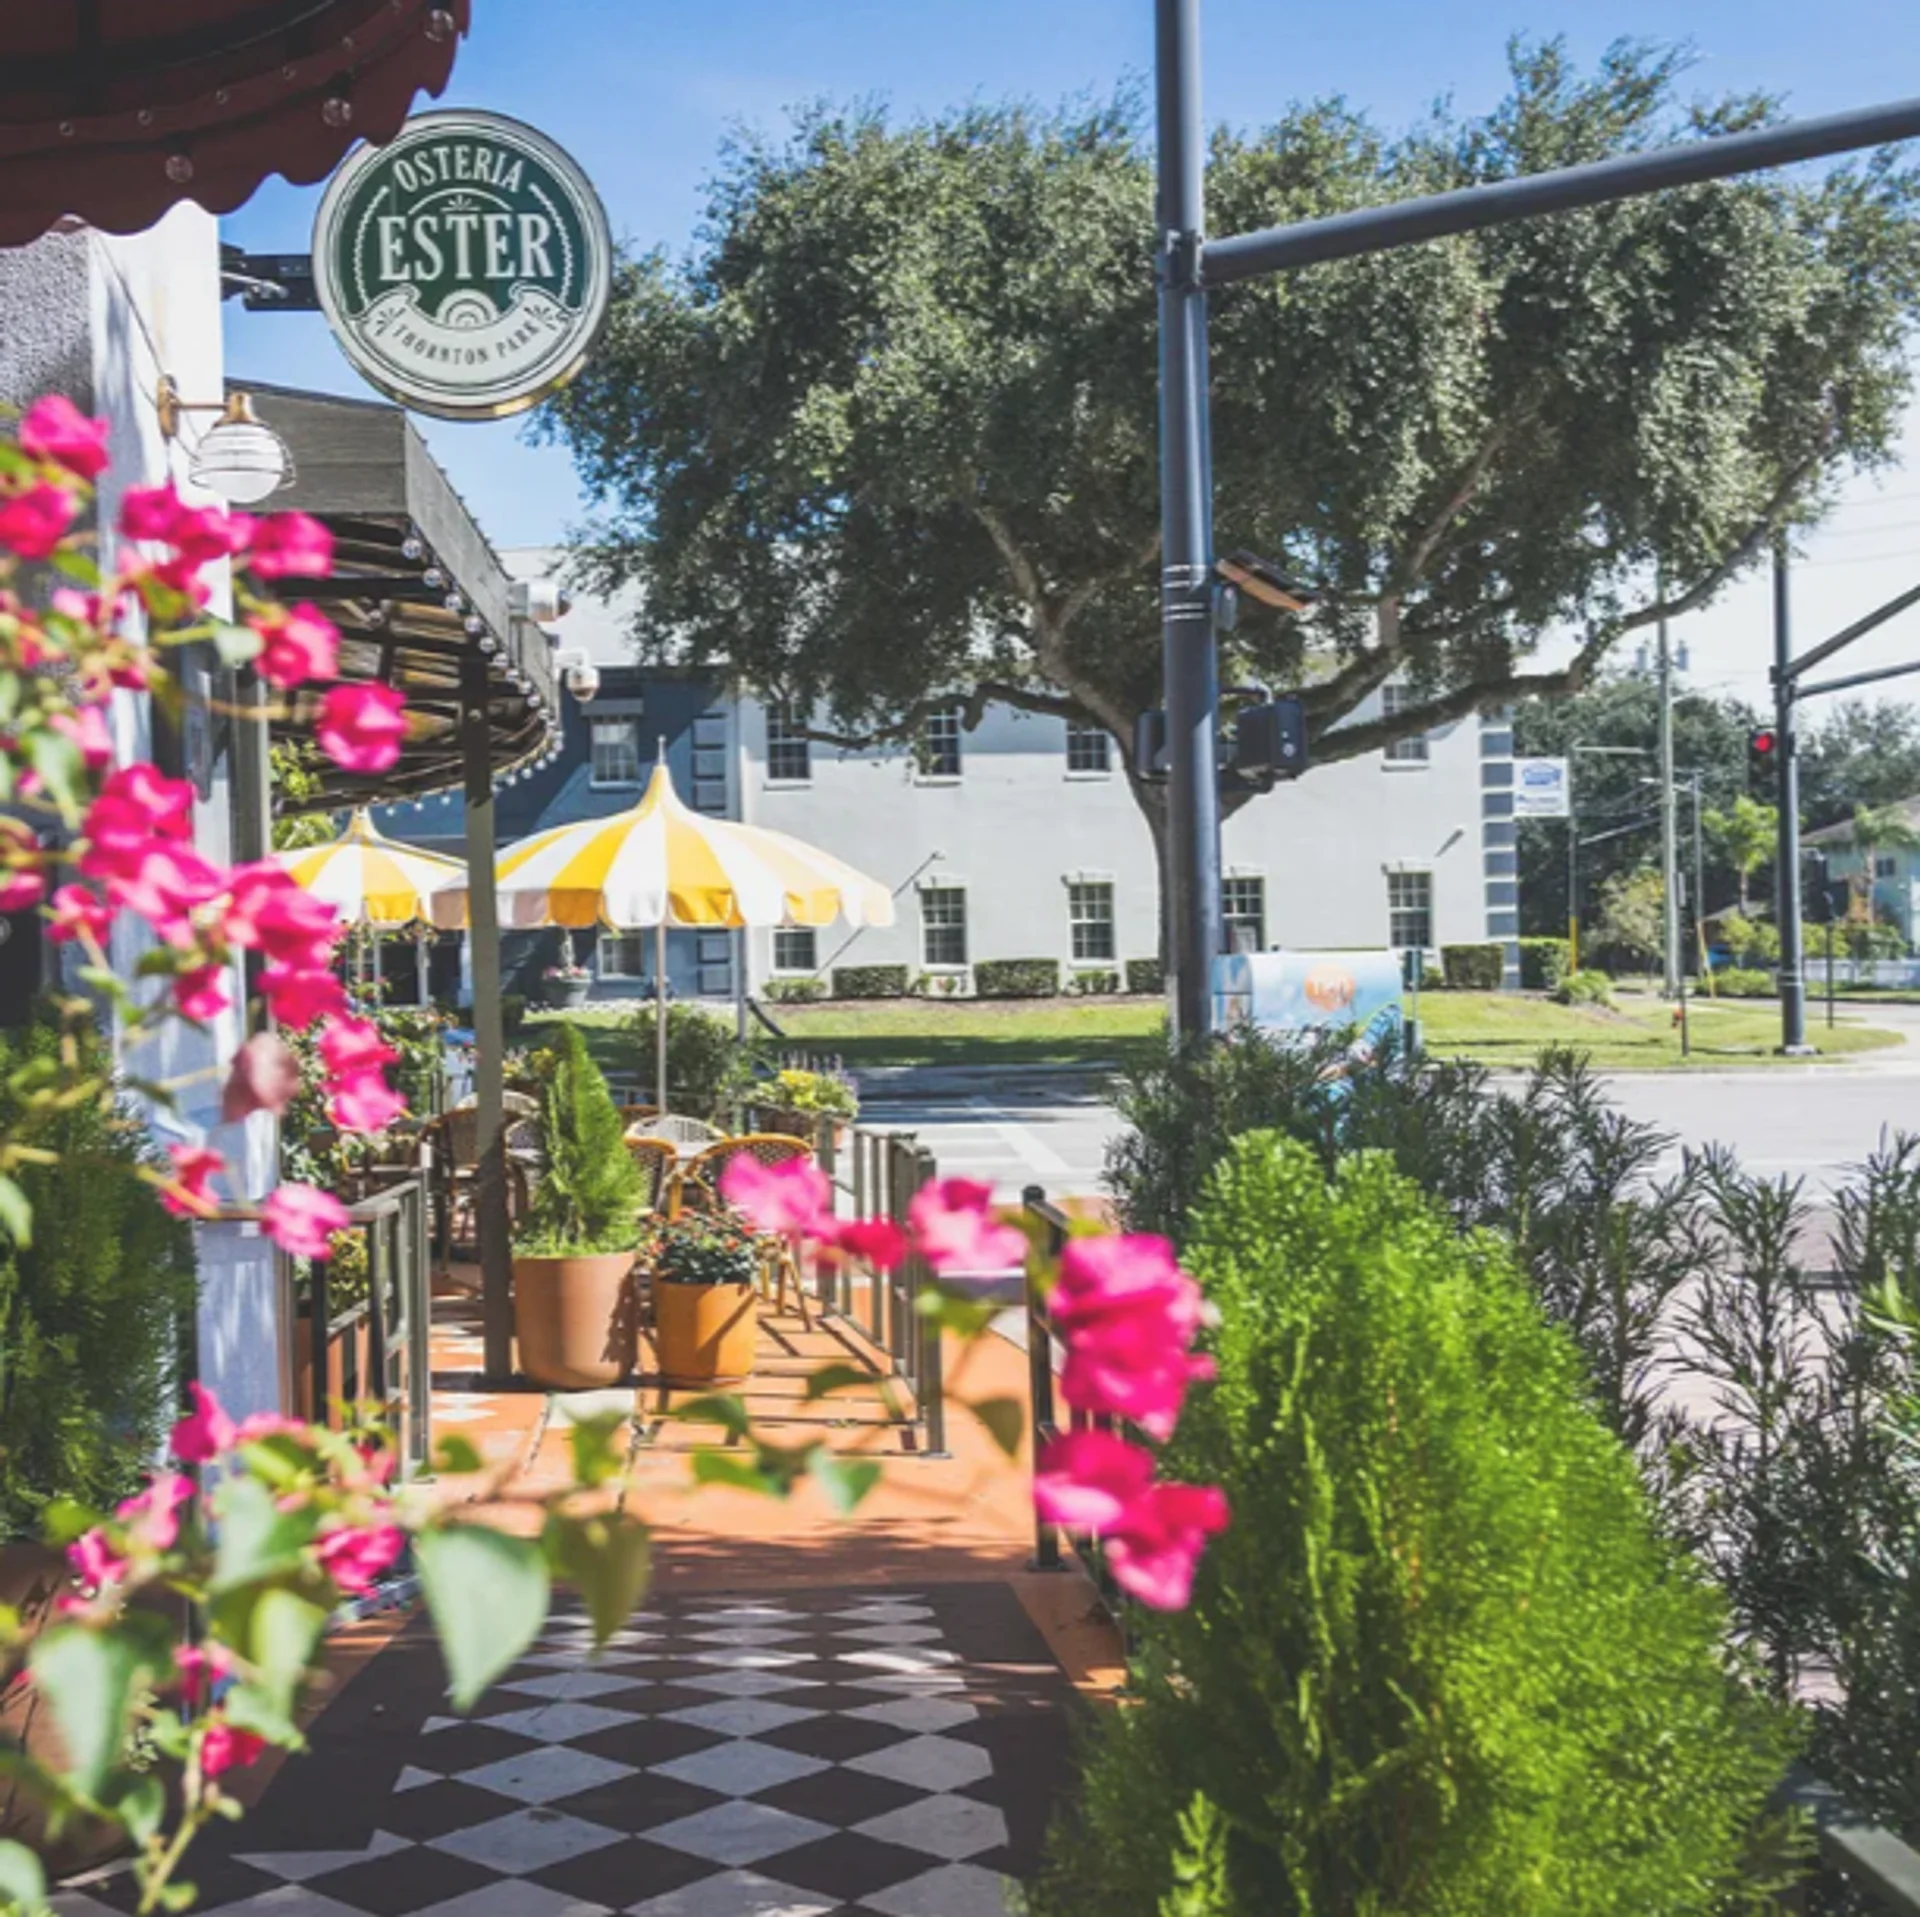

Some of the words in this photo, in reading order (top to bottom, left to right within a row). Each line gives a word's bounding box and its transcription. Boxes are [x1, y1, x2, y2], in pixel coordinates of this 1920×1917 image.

[393, 145, 523, 192] OSTERIA
[377, 213, 554, 281] ESTER
[393, 324, 488, 365] THORNTON
[496, 321, 540, 358] PARK
